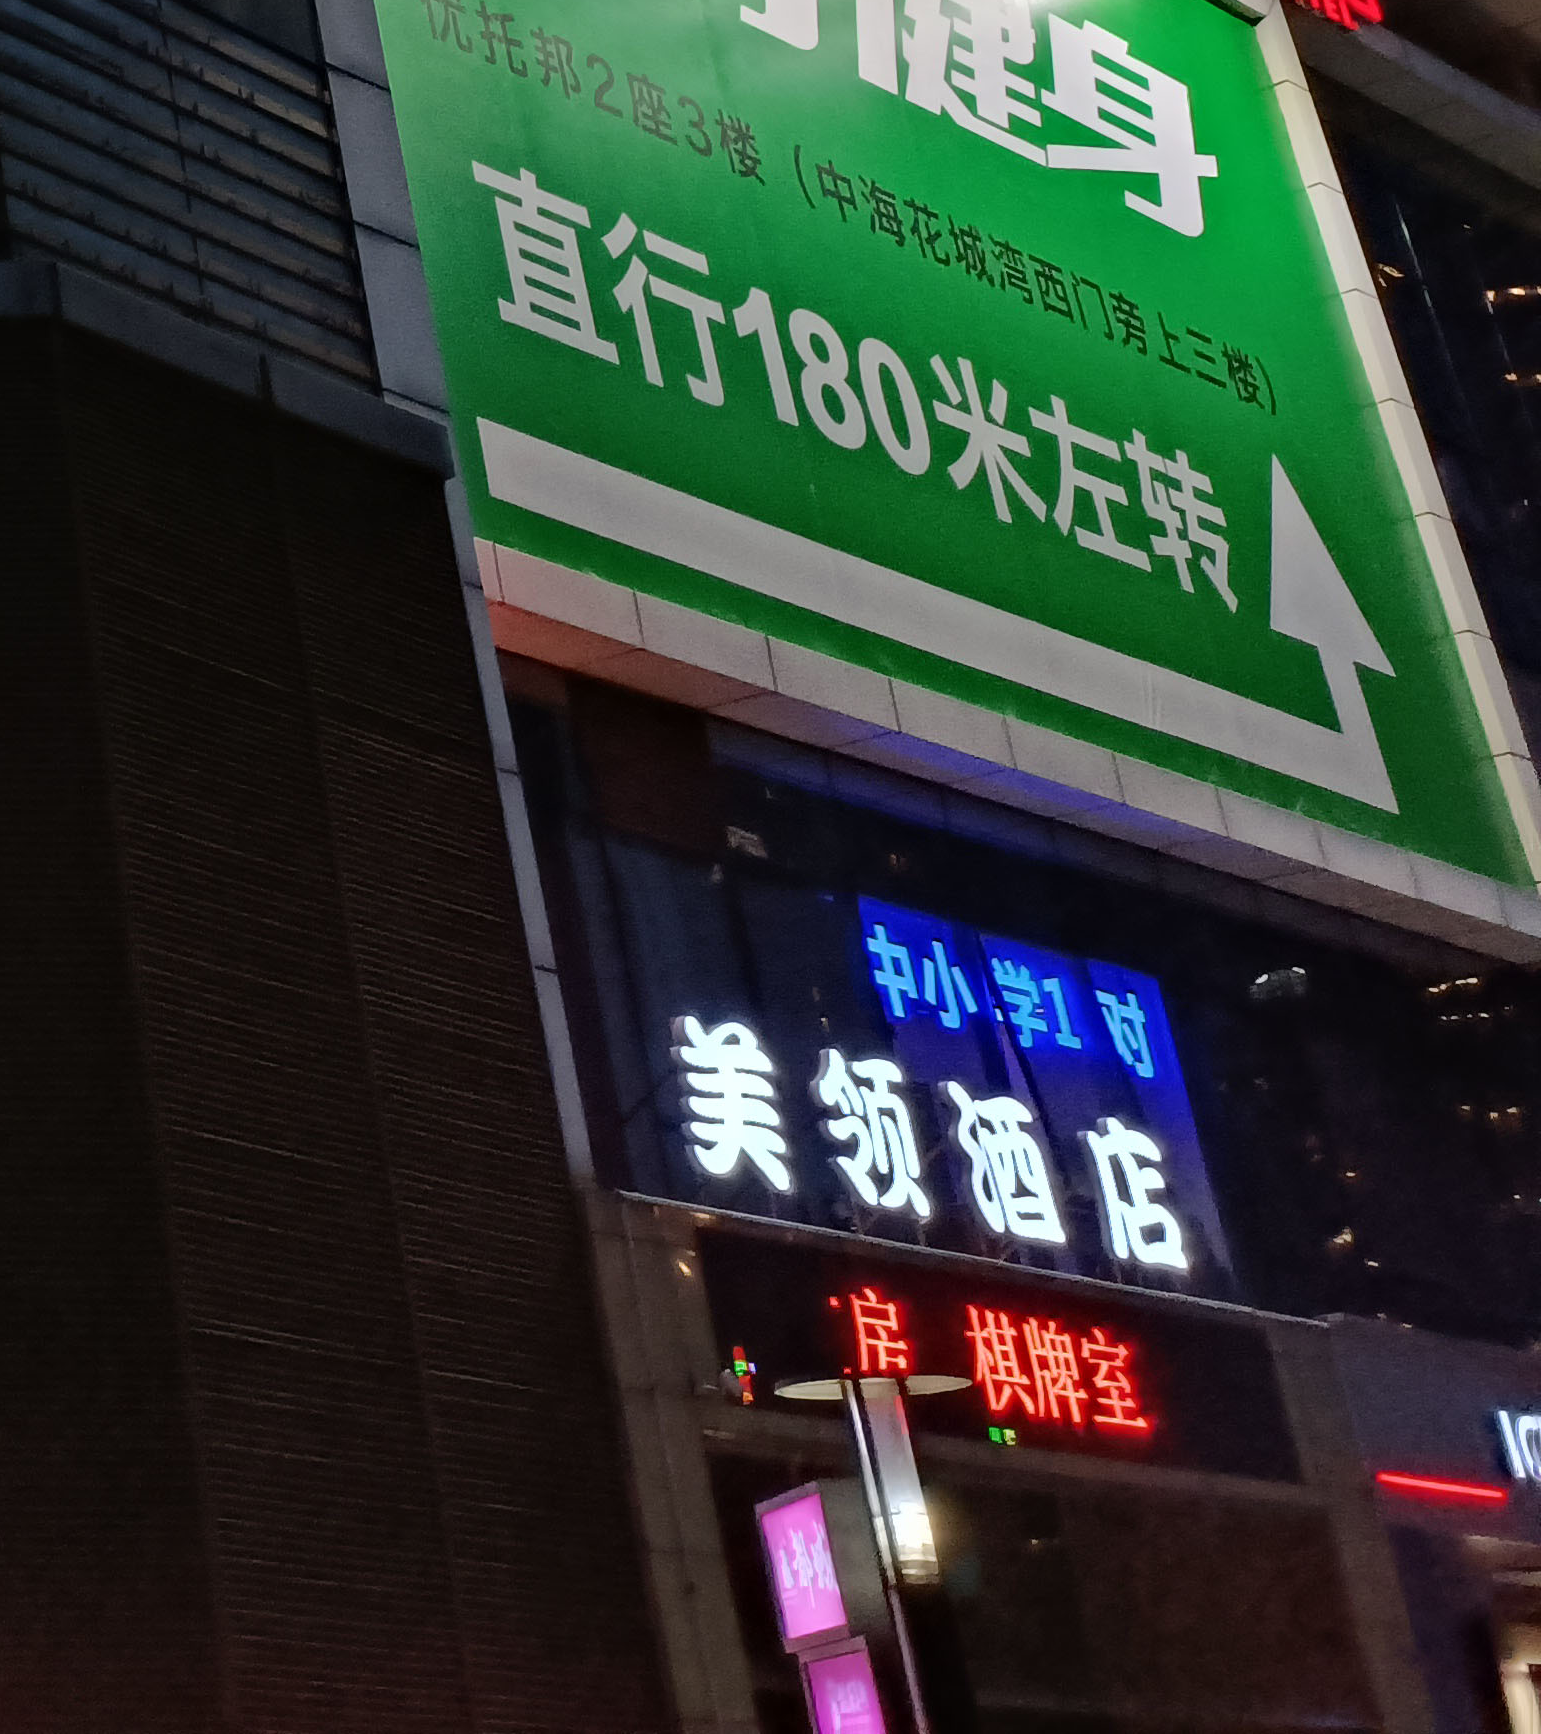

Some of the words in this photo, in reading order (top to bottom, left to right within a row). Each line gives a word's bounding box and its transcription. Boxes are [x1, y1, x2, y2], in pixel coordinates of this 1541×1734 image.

[471, 159, 1240, 614] 直行180米左转
[677, 1013, 1190, 1270] 美领酒店
[962, 1302, 1154, 1431] 棋牌室
